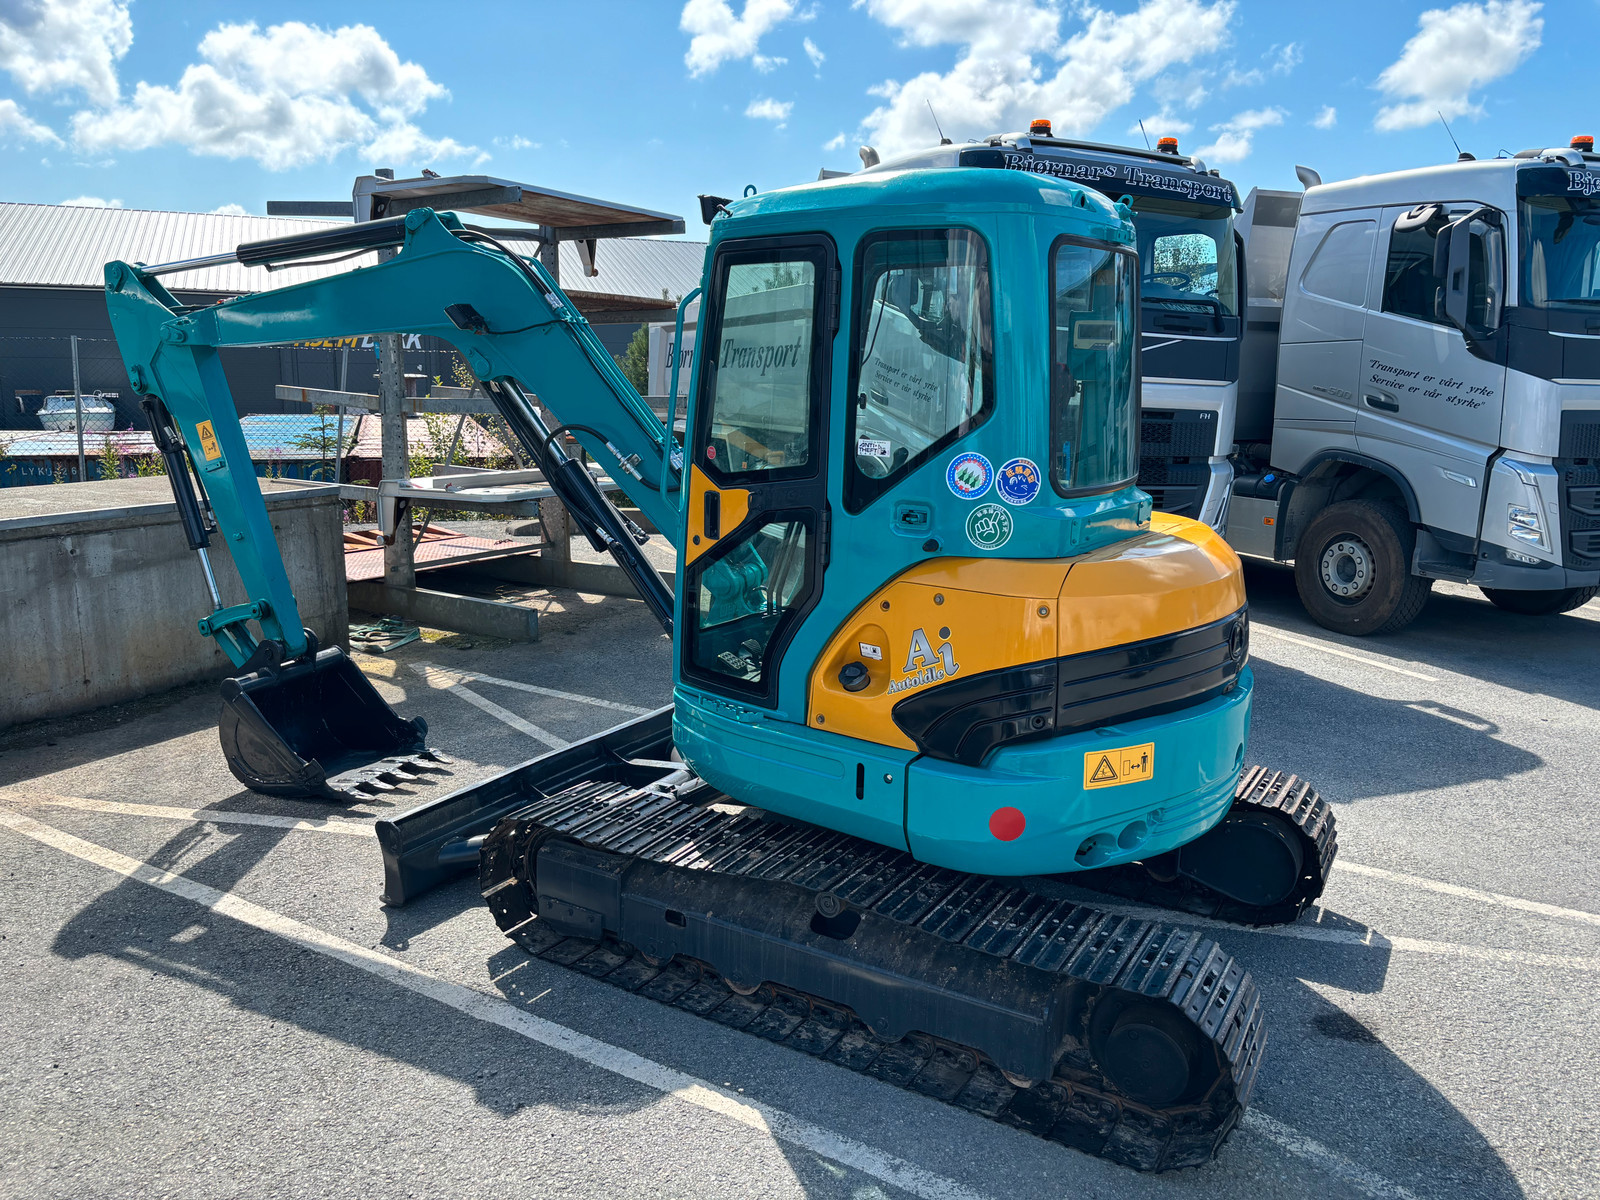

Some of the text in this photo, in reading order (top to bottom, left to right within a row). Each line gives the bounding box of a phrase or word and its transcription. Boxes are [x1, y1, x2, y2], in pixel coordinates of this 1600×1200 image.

[1124, 166, 1233, 202] Transport
[721, 336, 801, 376] Transport
[875, 370, 893, 384] Service
[1370, 374, 1405, 390] Service
[1423, 389, 1442, 399] vår
[1423, 375, 1435, 383] er
[1439, 378, 1463, 389] vårt
[1466, 385, 1494, 397] yrke
[903, 626, 960, 676] Ai
